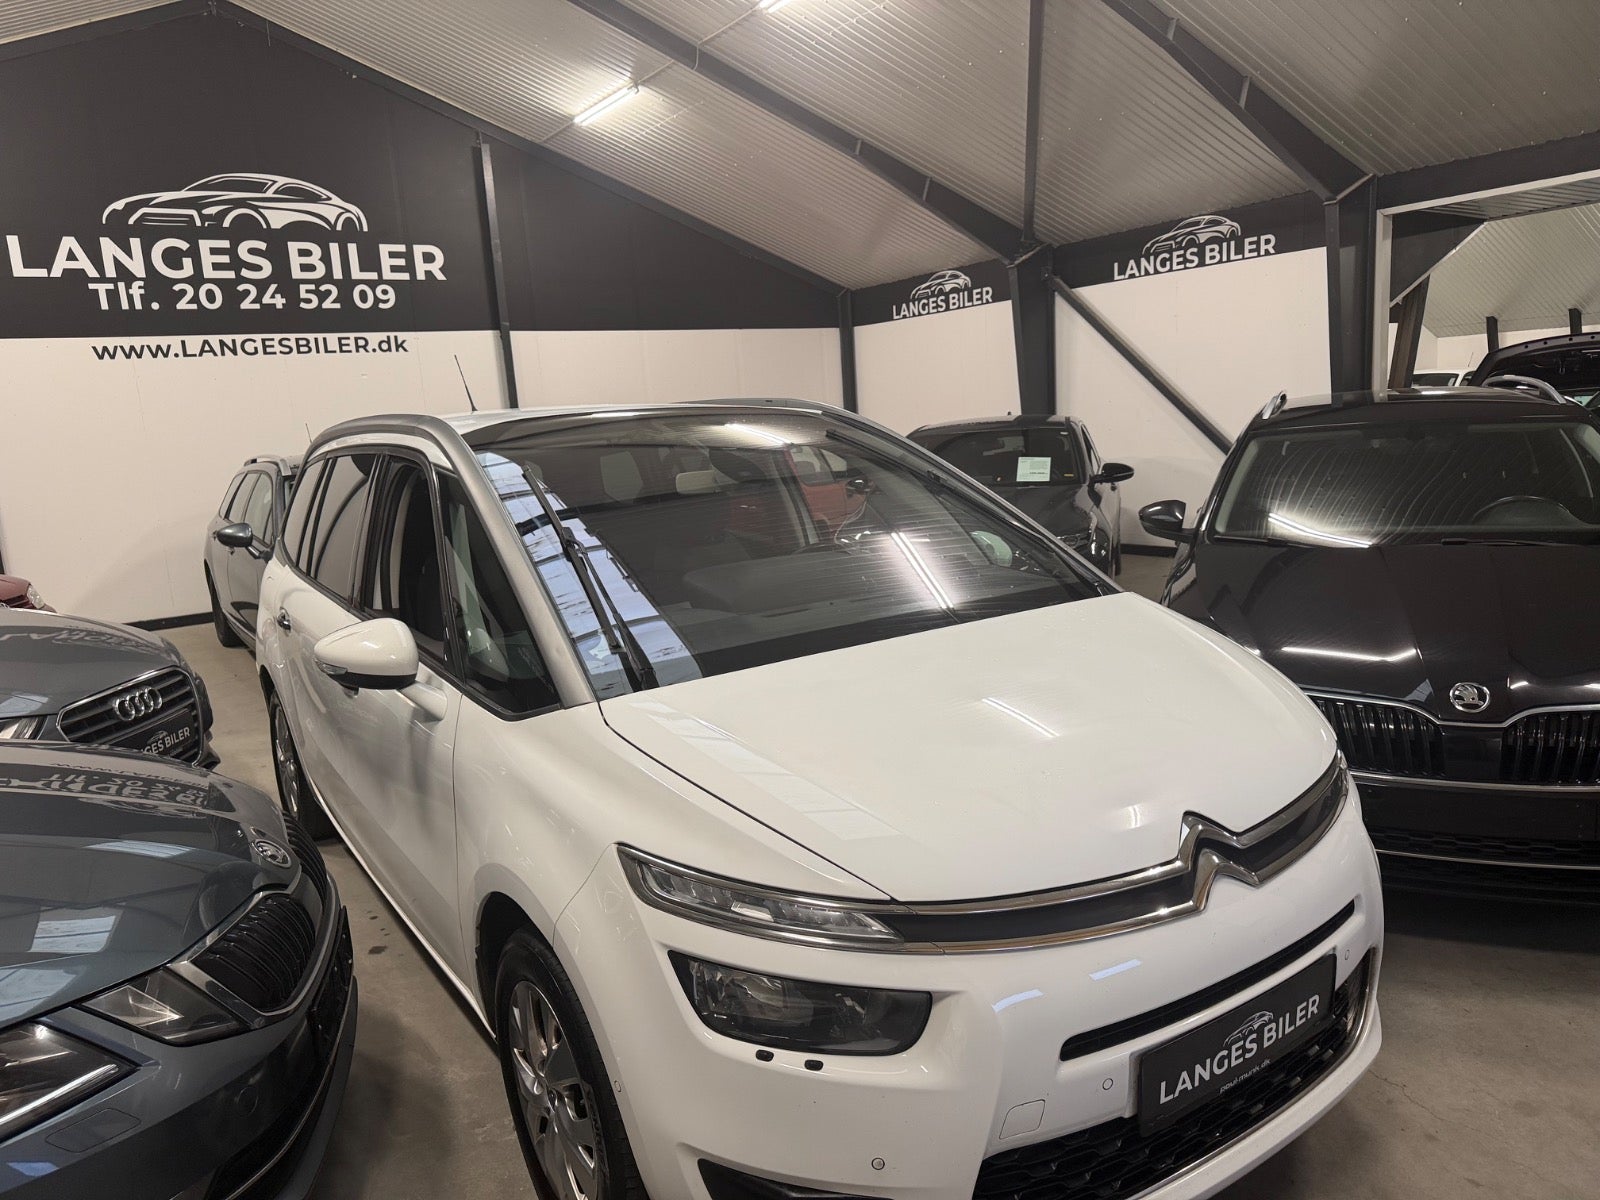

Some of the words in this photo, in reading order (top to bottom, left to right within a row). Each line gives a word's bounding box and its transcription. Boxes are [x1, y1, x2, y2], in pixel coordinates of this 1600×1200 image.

[6, 234, 273, 281] LANGES
[287, 241, 448, 281] BILER
[1112, 249, 1199, 281] LANGES
[1204, 233, 1277, 265] BILER
[88, 281, 161, 311] Tlf.
[172, 283, 223, 310] 20
[236, 283, 287, 310] 24
[299, 284, 341, 309] 52
[352, 284, 396, 309] 09
[892, 296, 947, 320] LANGES
[948, 286, 993, 310] BILER
[91, 335, 409, 361] www.LANGESBILER.dk
[164, 726, 191, 748] BILER
[1159, 1033, 1258, 1105] LANGES
[1263, 994, 1320, 1049] BILER
